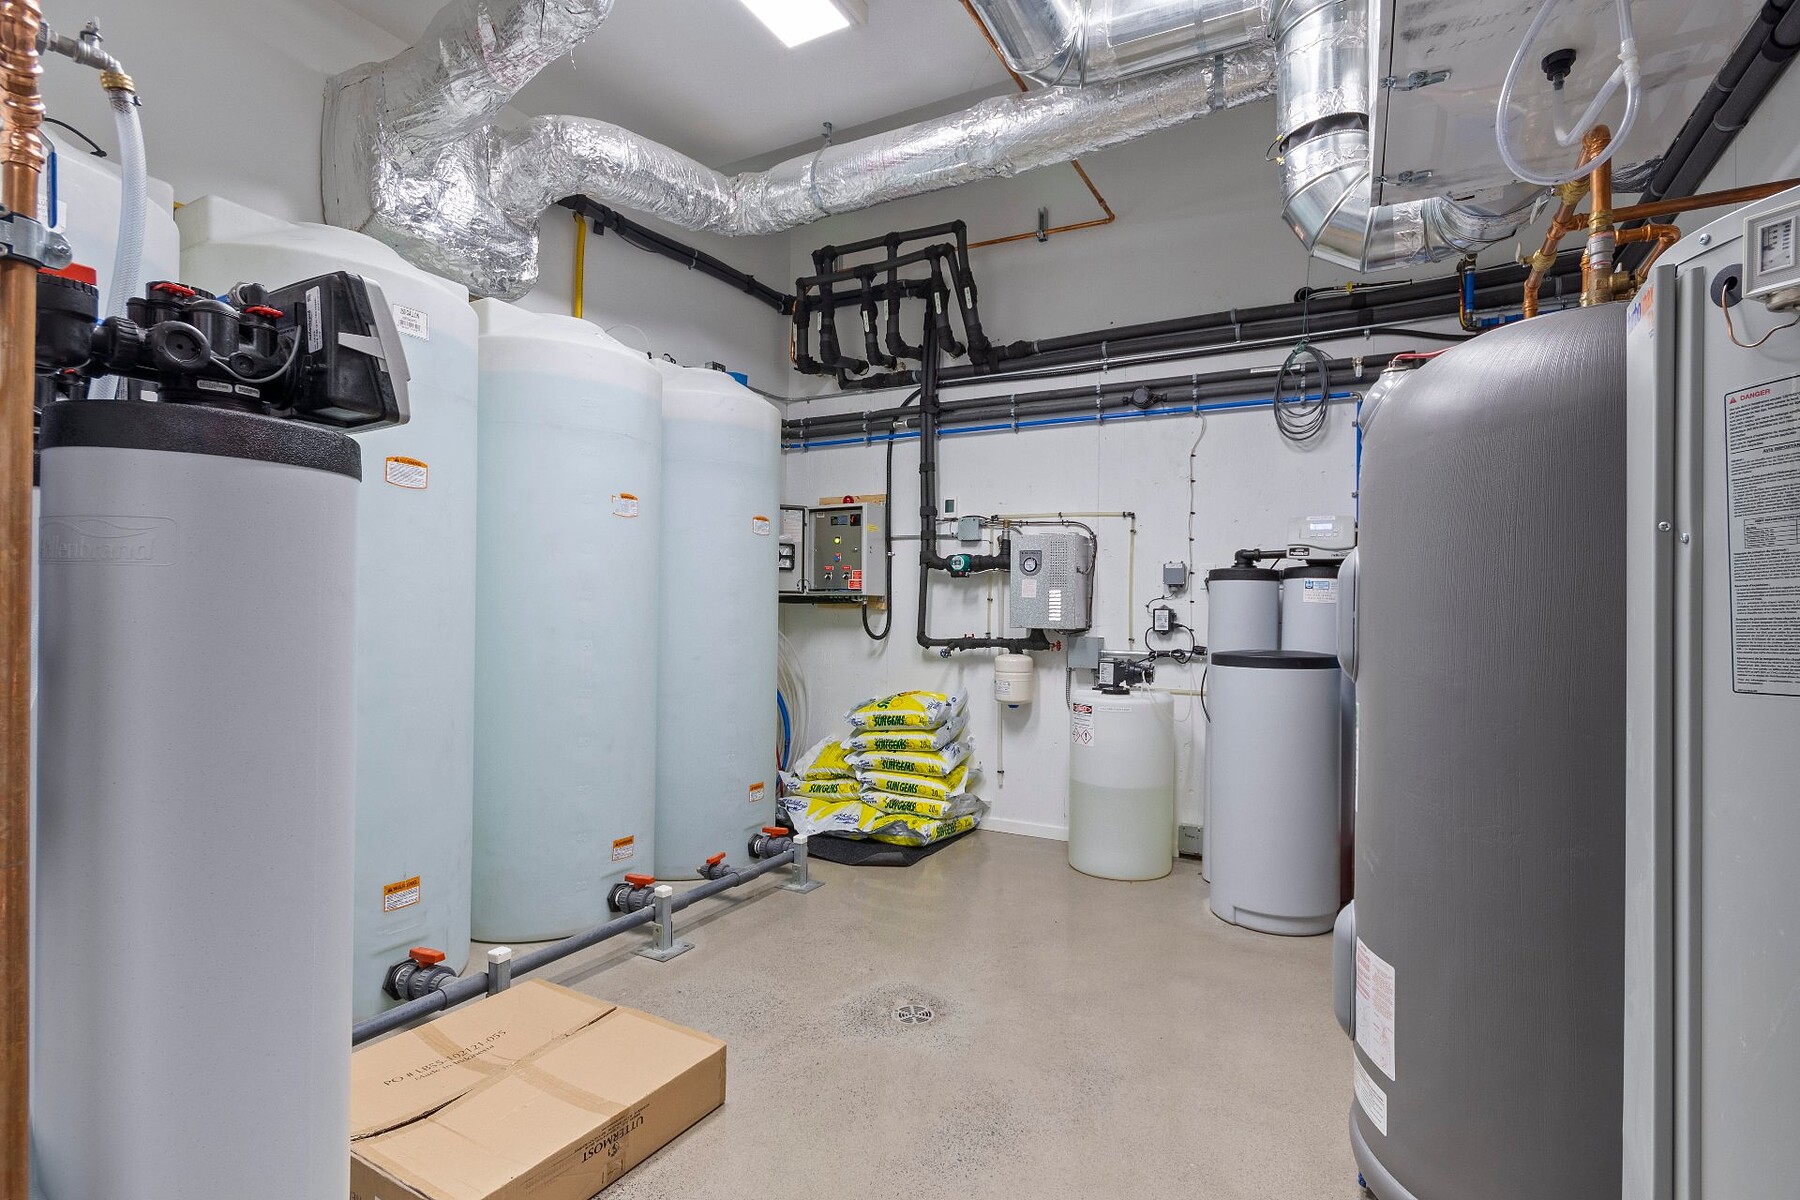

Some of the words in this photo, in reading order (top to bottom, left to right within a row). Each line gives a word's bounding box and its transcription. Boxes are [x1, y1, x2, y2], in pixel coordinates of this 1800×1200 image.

[1740, 389, 1770, 401] DANGER
[822, 784, 840, 794] GEMS
[886, 780, 899, 792] SUN
[900, 782, 919, 794] GEMS
[393, 879, 418, 891] WARNING
[383, 1076, 404, 1087] PO
[581, 1115, 644, 1164] UTTERMOST
